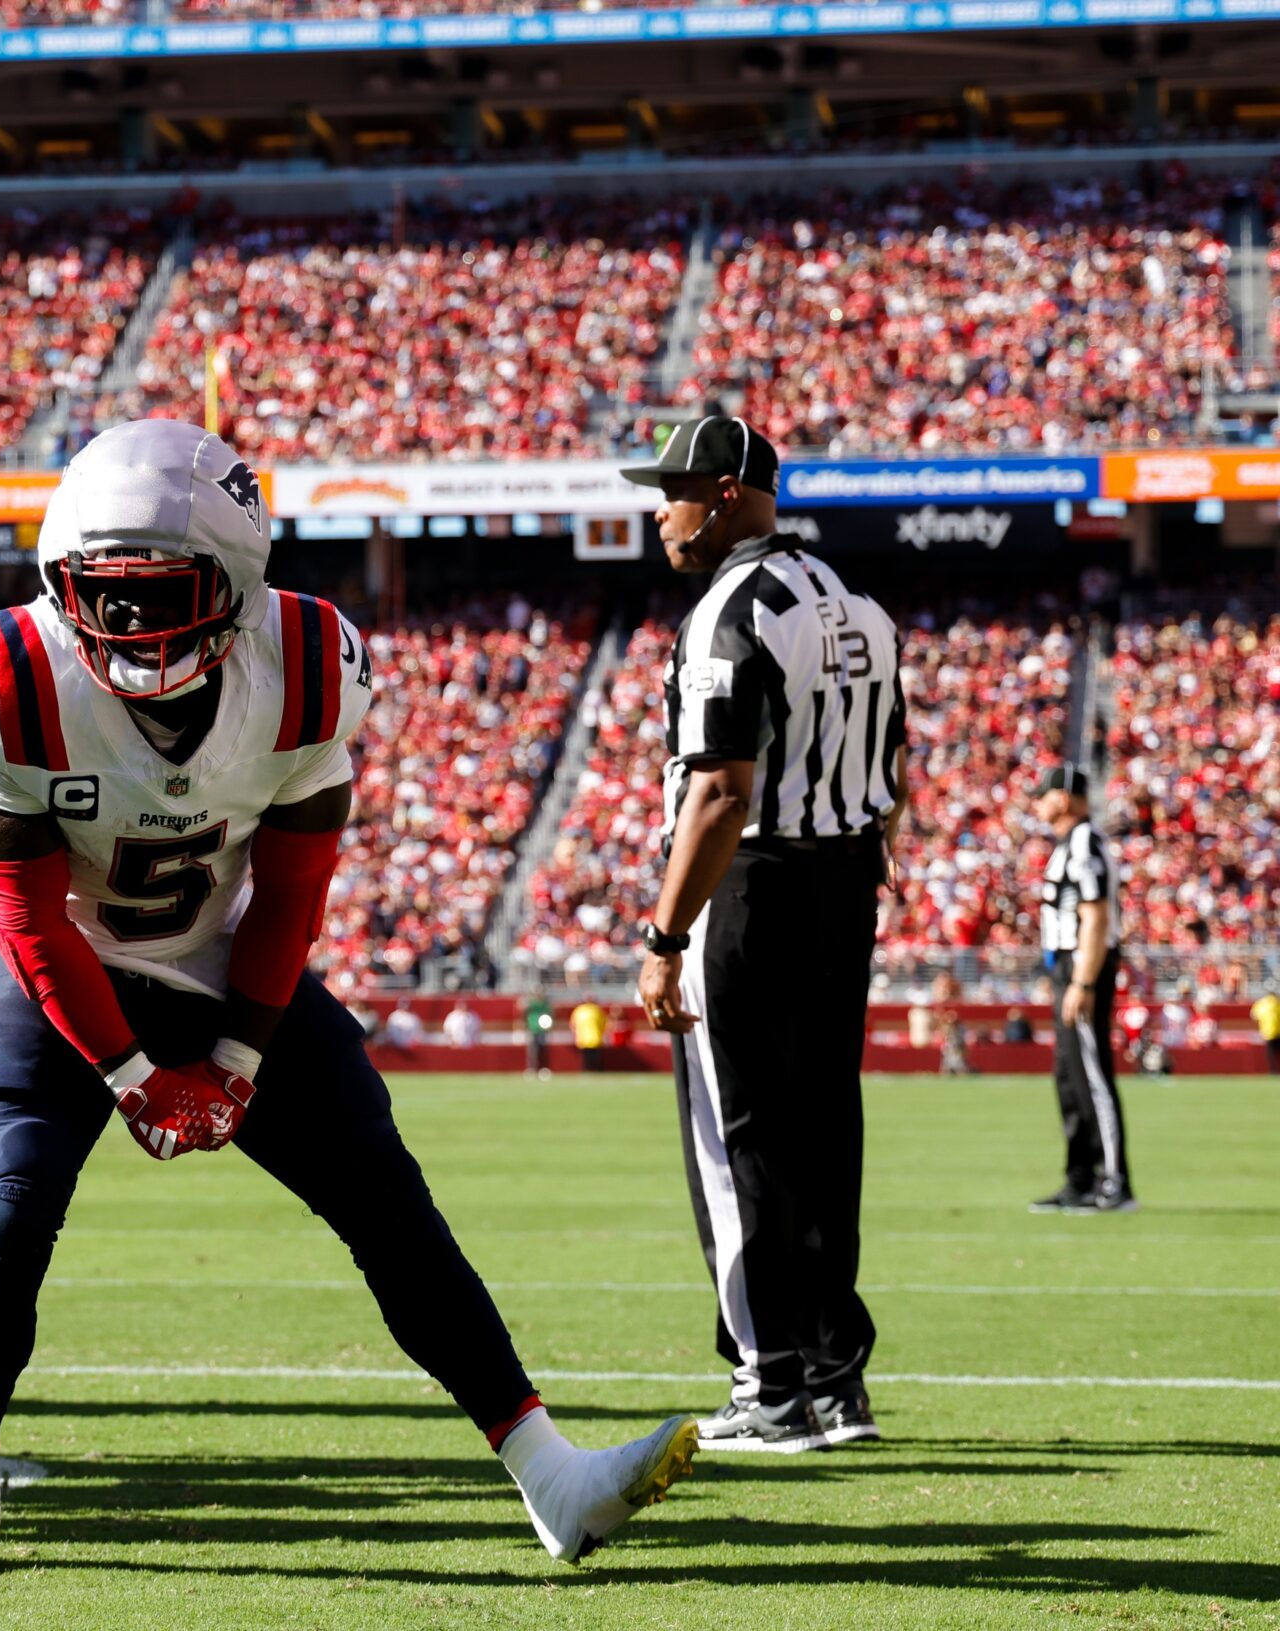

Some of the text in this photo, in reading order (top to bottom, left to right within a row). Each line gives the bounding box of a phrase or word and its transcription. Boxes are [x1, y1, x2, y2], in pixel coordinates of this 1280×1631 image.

[895, 503, 1013, 550] xfinity
[821, 629, 872, 683] 43
[53, 780, 96, 811] C
[138, 809, 209, 828] PATRIOTS
[96, 818, 228, 943] 5
